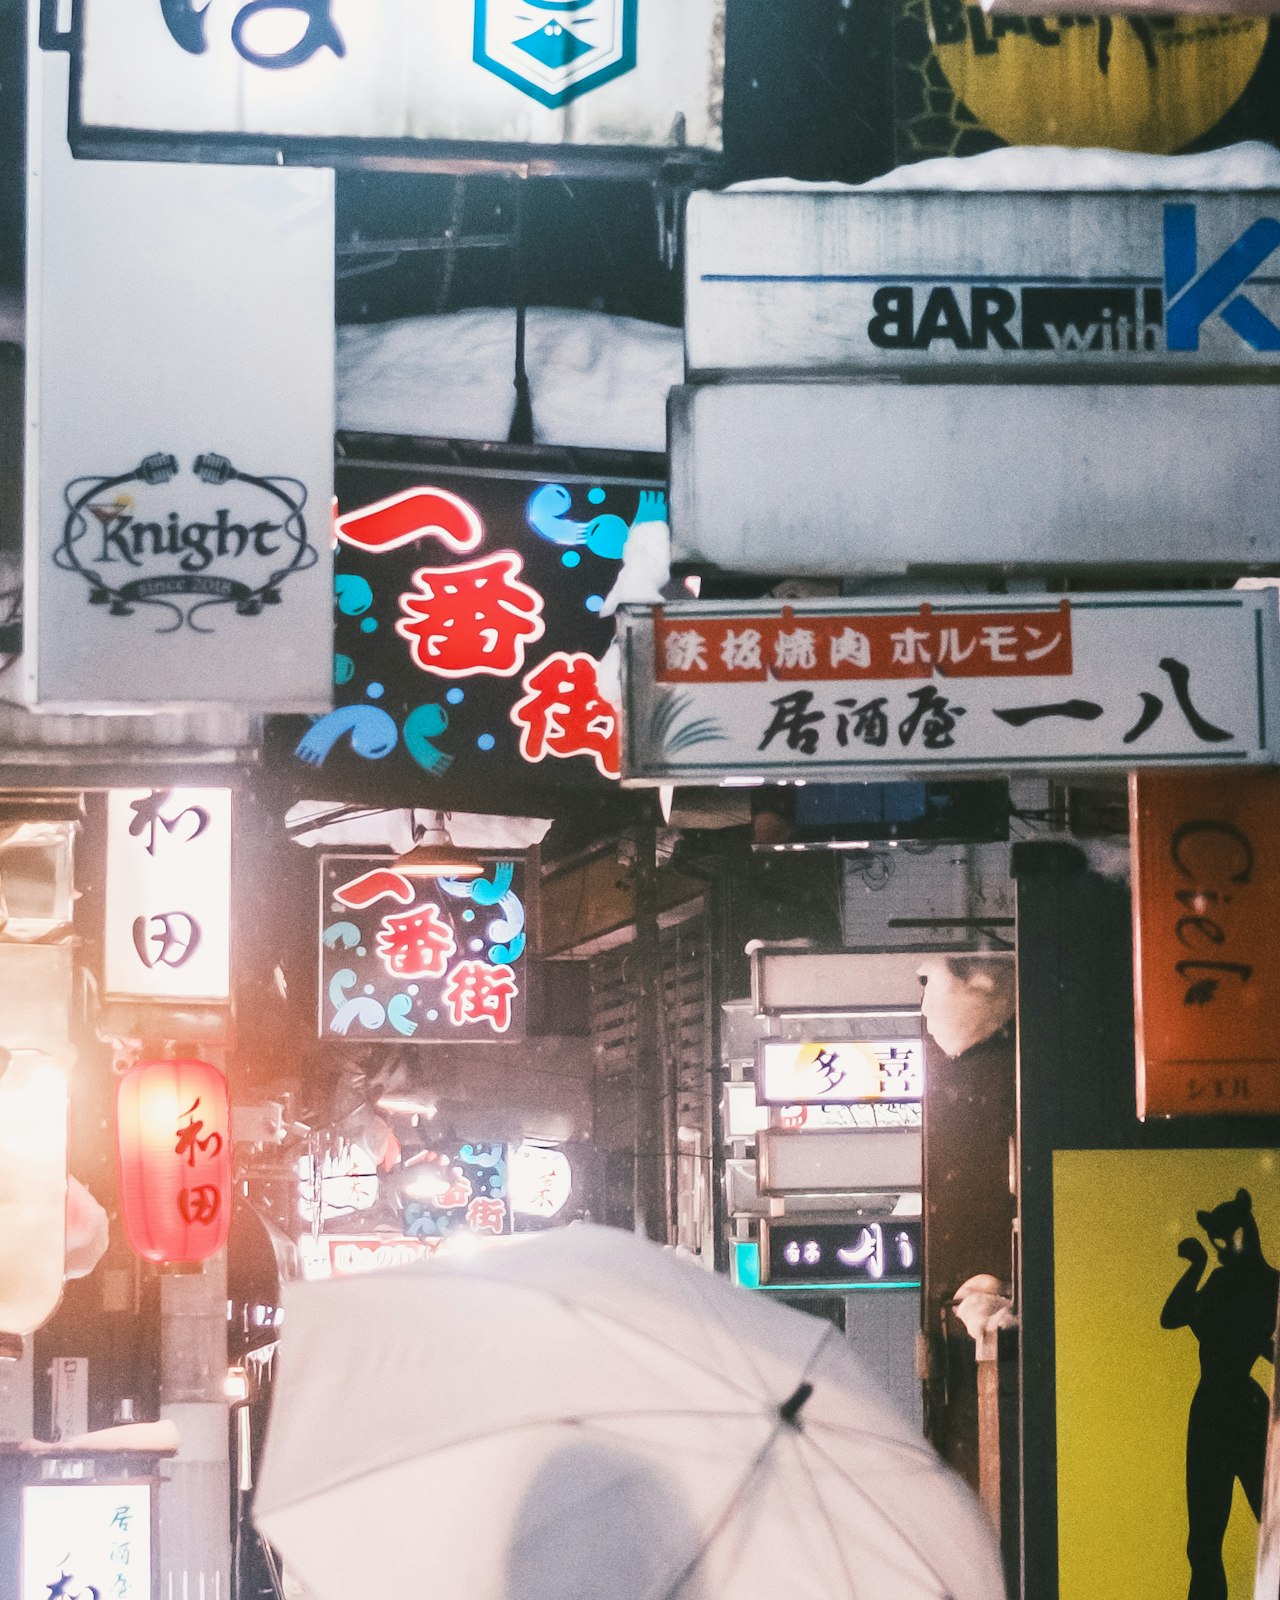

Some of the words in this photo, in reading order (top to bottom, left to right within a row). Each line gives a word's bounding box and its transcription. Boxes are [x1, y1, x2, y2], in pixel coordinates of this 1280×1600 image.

[867, 286, 1022, 352] BAR
[1042, 286, 1166, 352] with
[92, 506, 283, 572] Knight
[333, 866, 519, 1032] 一番街
